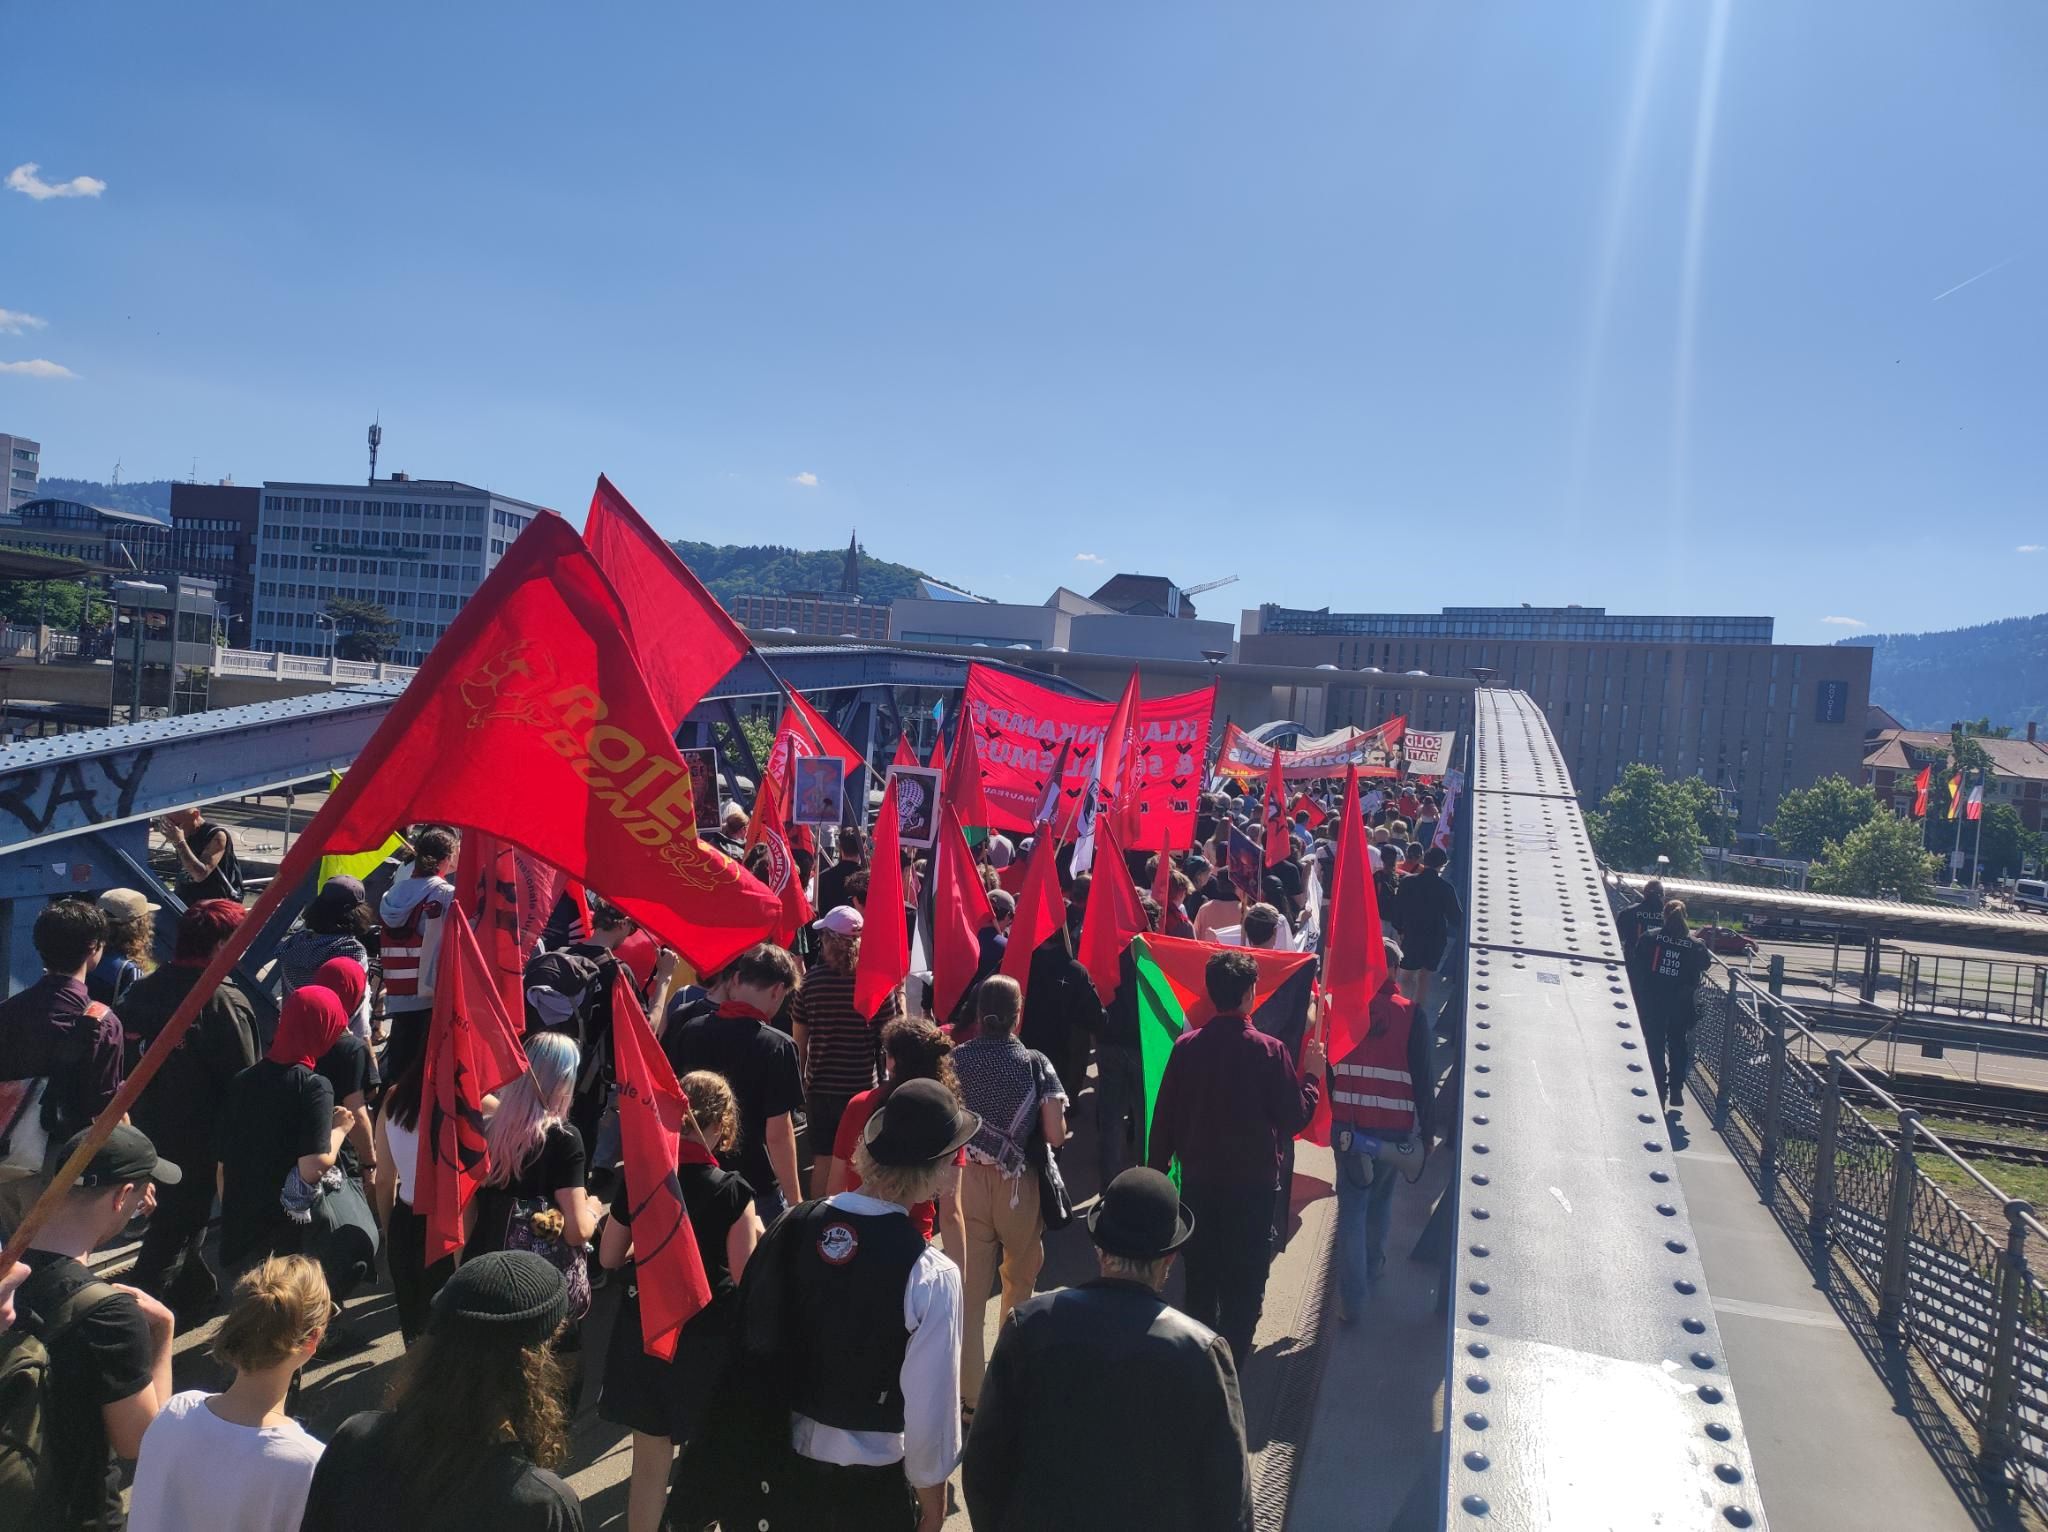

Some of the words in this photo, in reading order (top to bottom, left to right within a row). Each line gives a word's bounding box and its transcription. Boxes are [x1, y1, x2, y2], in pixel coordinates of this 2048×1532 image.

[1826, 682, 1836, 721] NOVOTEL
[541, 728, 673, 847] BUND
[1656, 935, 1693, 949] POLIZEI
[1665, 949, 1680, 959] BW
